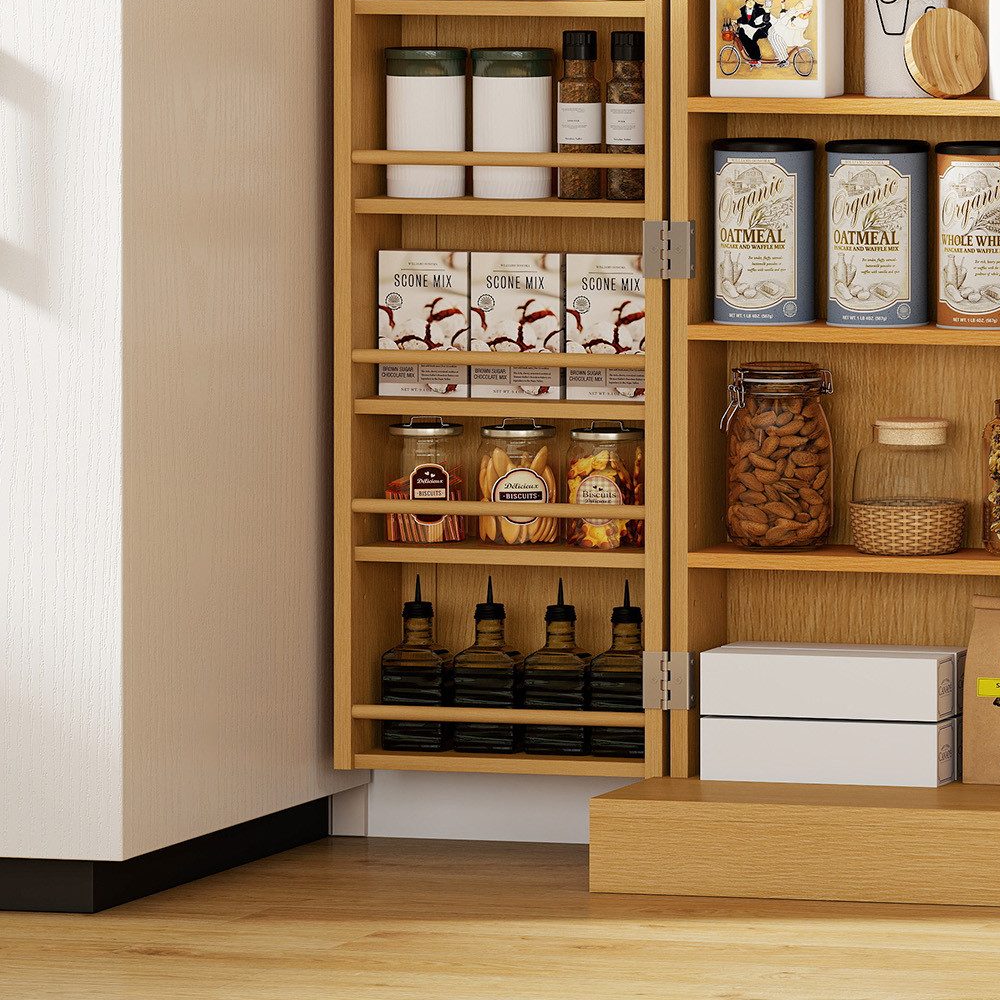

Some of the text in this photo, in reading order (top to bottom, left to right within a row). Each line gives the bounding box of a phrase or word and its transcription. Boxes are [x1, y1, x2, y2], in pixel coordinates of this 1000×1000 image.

[719, 176, 784, 225] Organic
[832, 178, 899, 228] Organic
[720, 227, 786, 243] OATMEAL
[833, 229, 900, 245] OATMEAL
[941, 233, 974, 246] WHOLE
[394, 273, 452, 288] SCONE MIX
[486, 275, 545, 290] SCONE MIX
[581, 277, 641, 291] SCONE MIX
[582, 490, 617, 499] Biscuits
